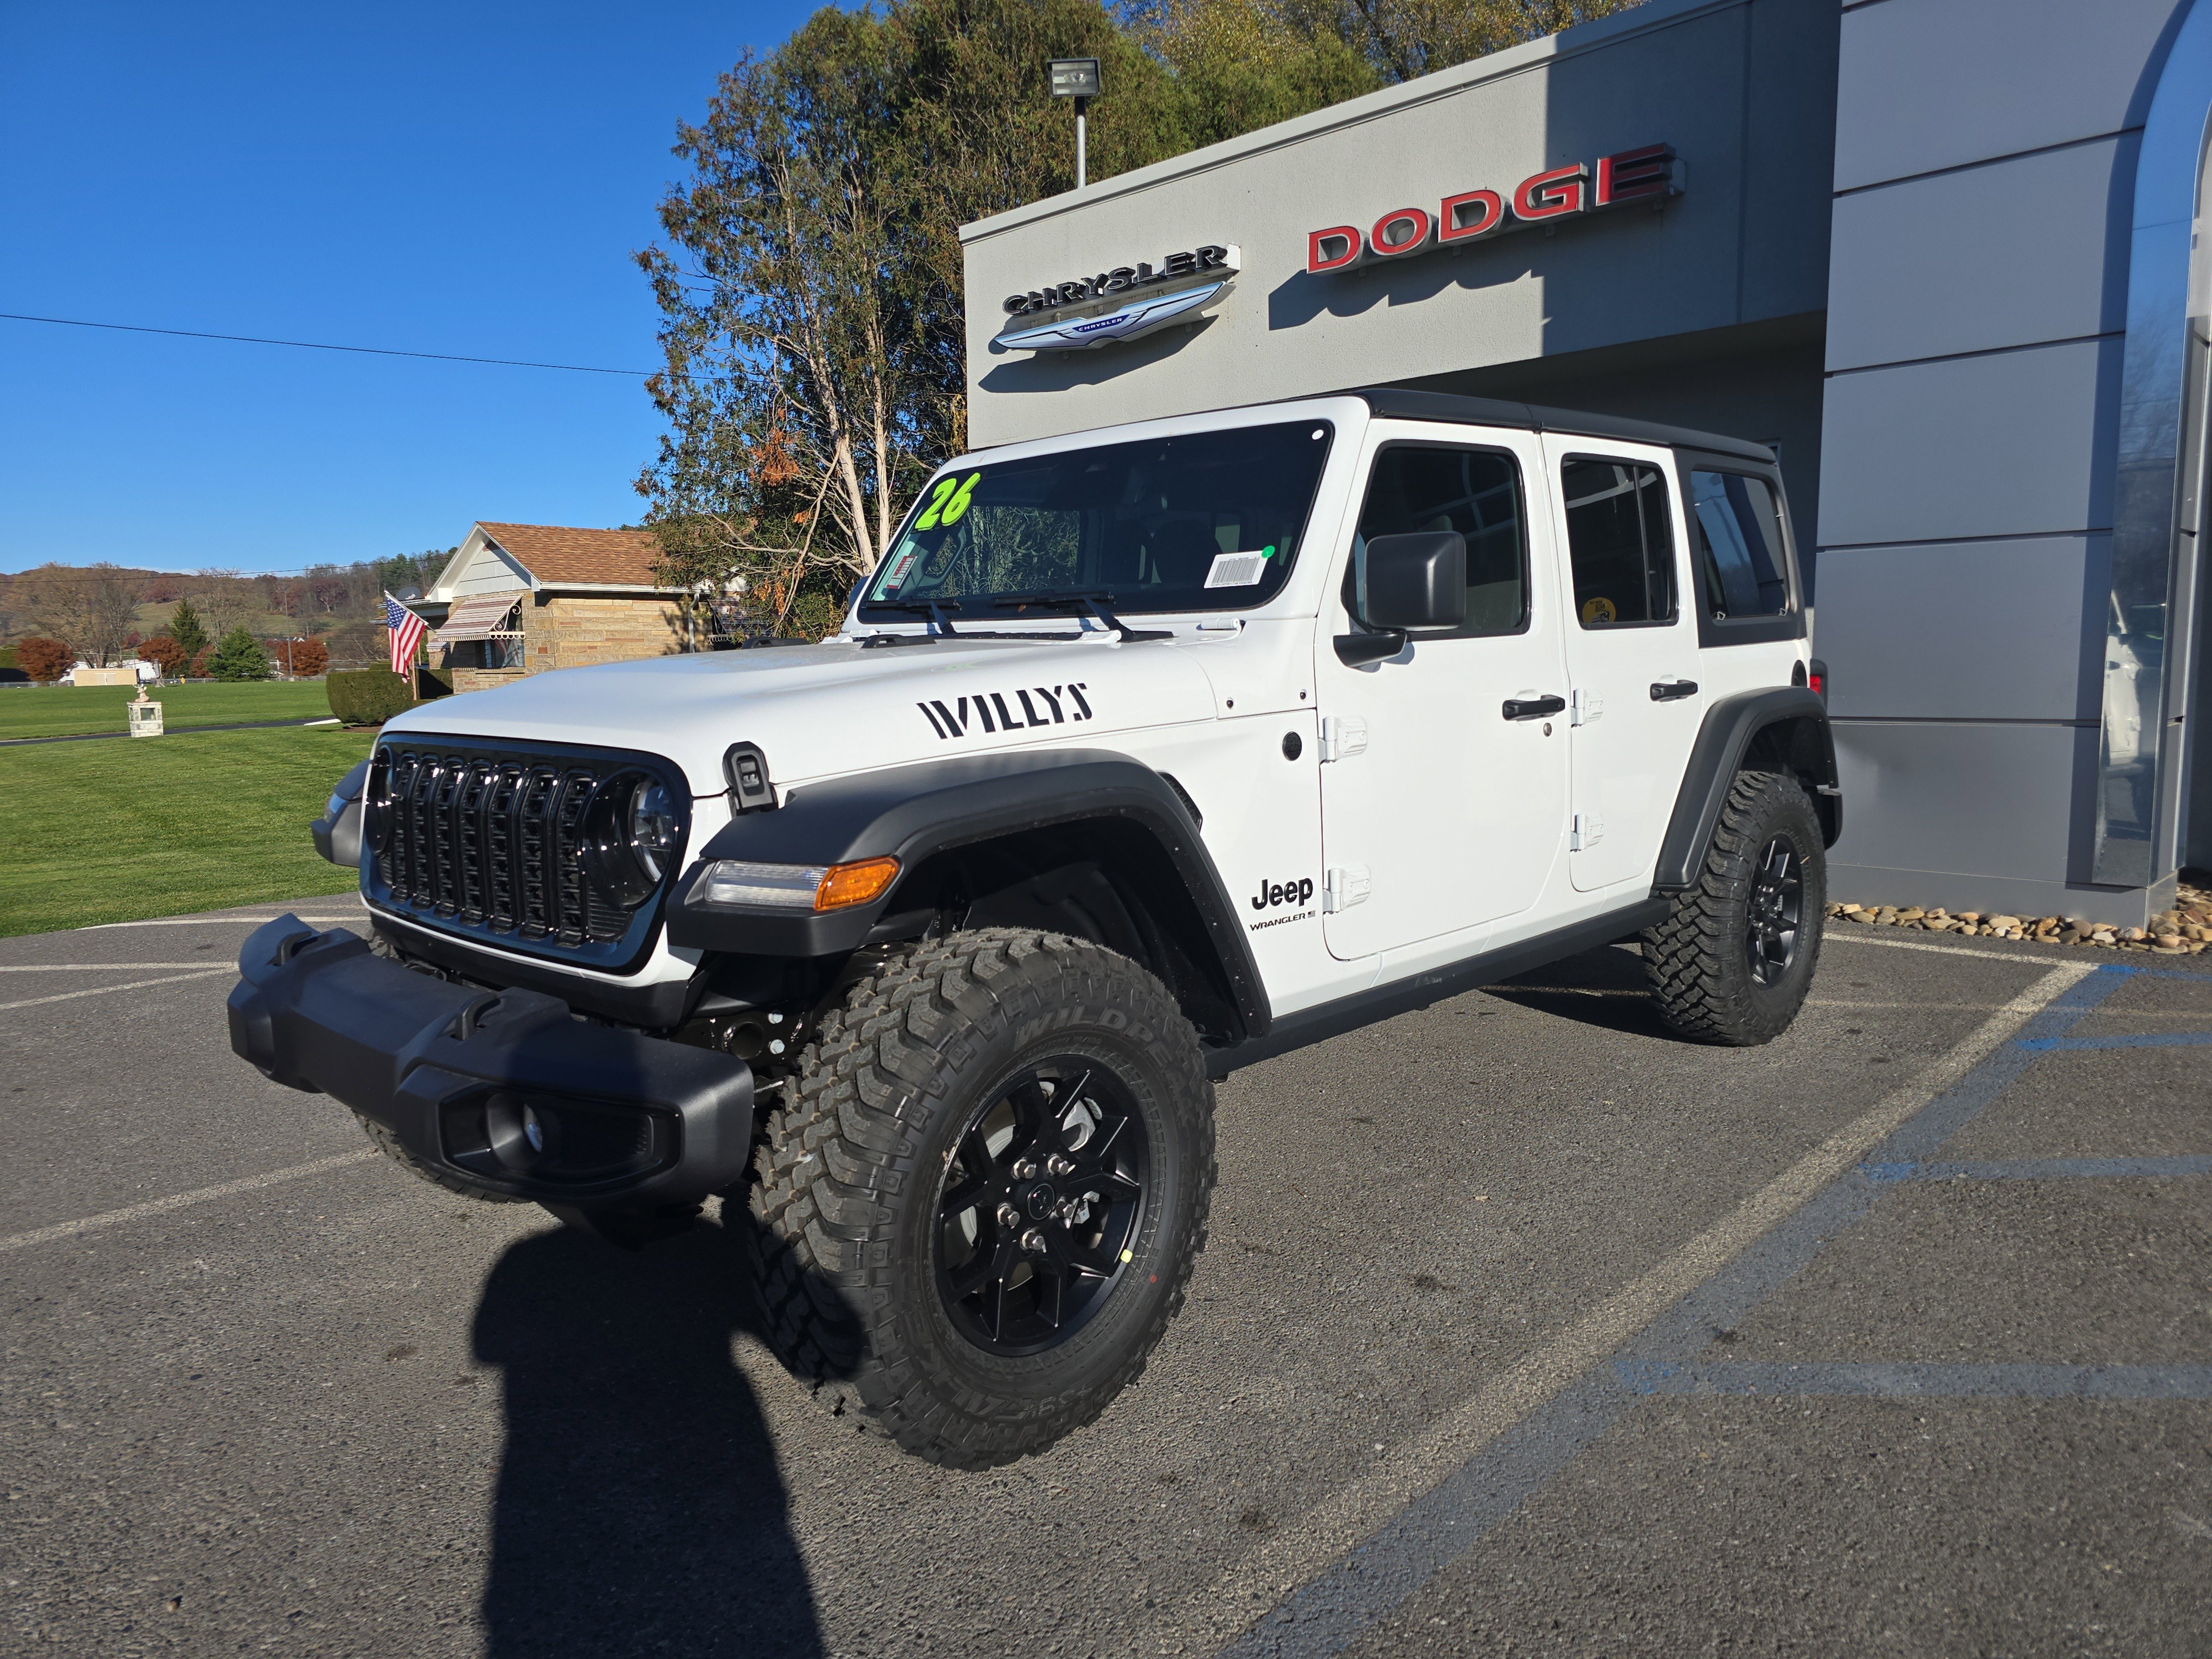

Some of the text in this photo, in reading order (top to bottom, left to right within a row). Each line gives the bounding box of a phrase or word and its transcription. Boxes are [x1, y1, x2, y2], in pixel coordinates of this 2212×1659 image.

[1307, 143, 1676, 274] DODGE
[1002, 245, 1228, 314] CHRYSLER
[1078, 318, 1122, 331] CHRYSLER
[913, 472, 981, 532] 26
[916, 683, 1092, 739] WILLYS
[1250, 912, 1306, 931] WRANGLER
[1251, 878, 1313, 910] Jeep
